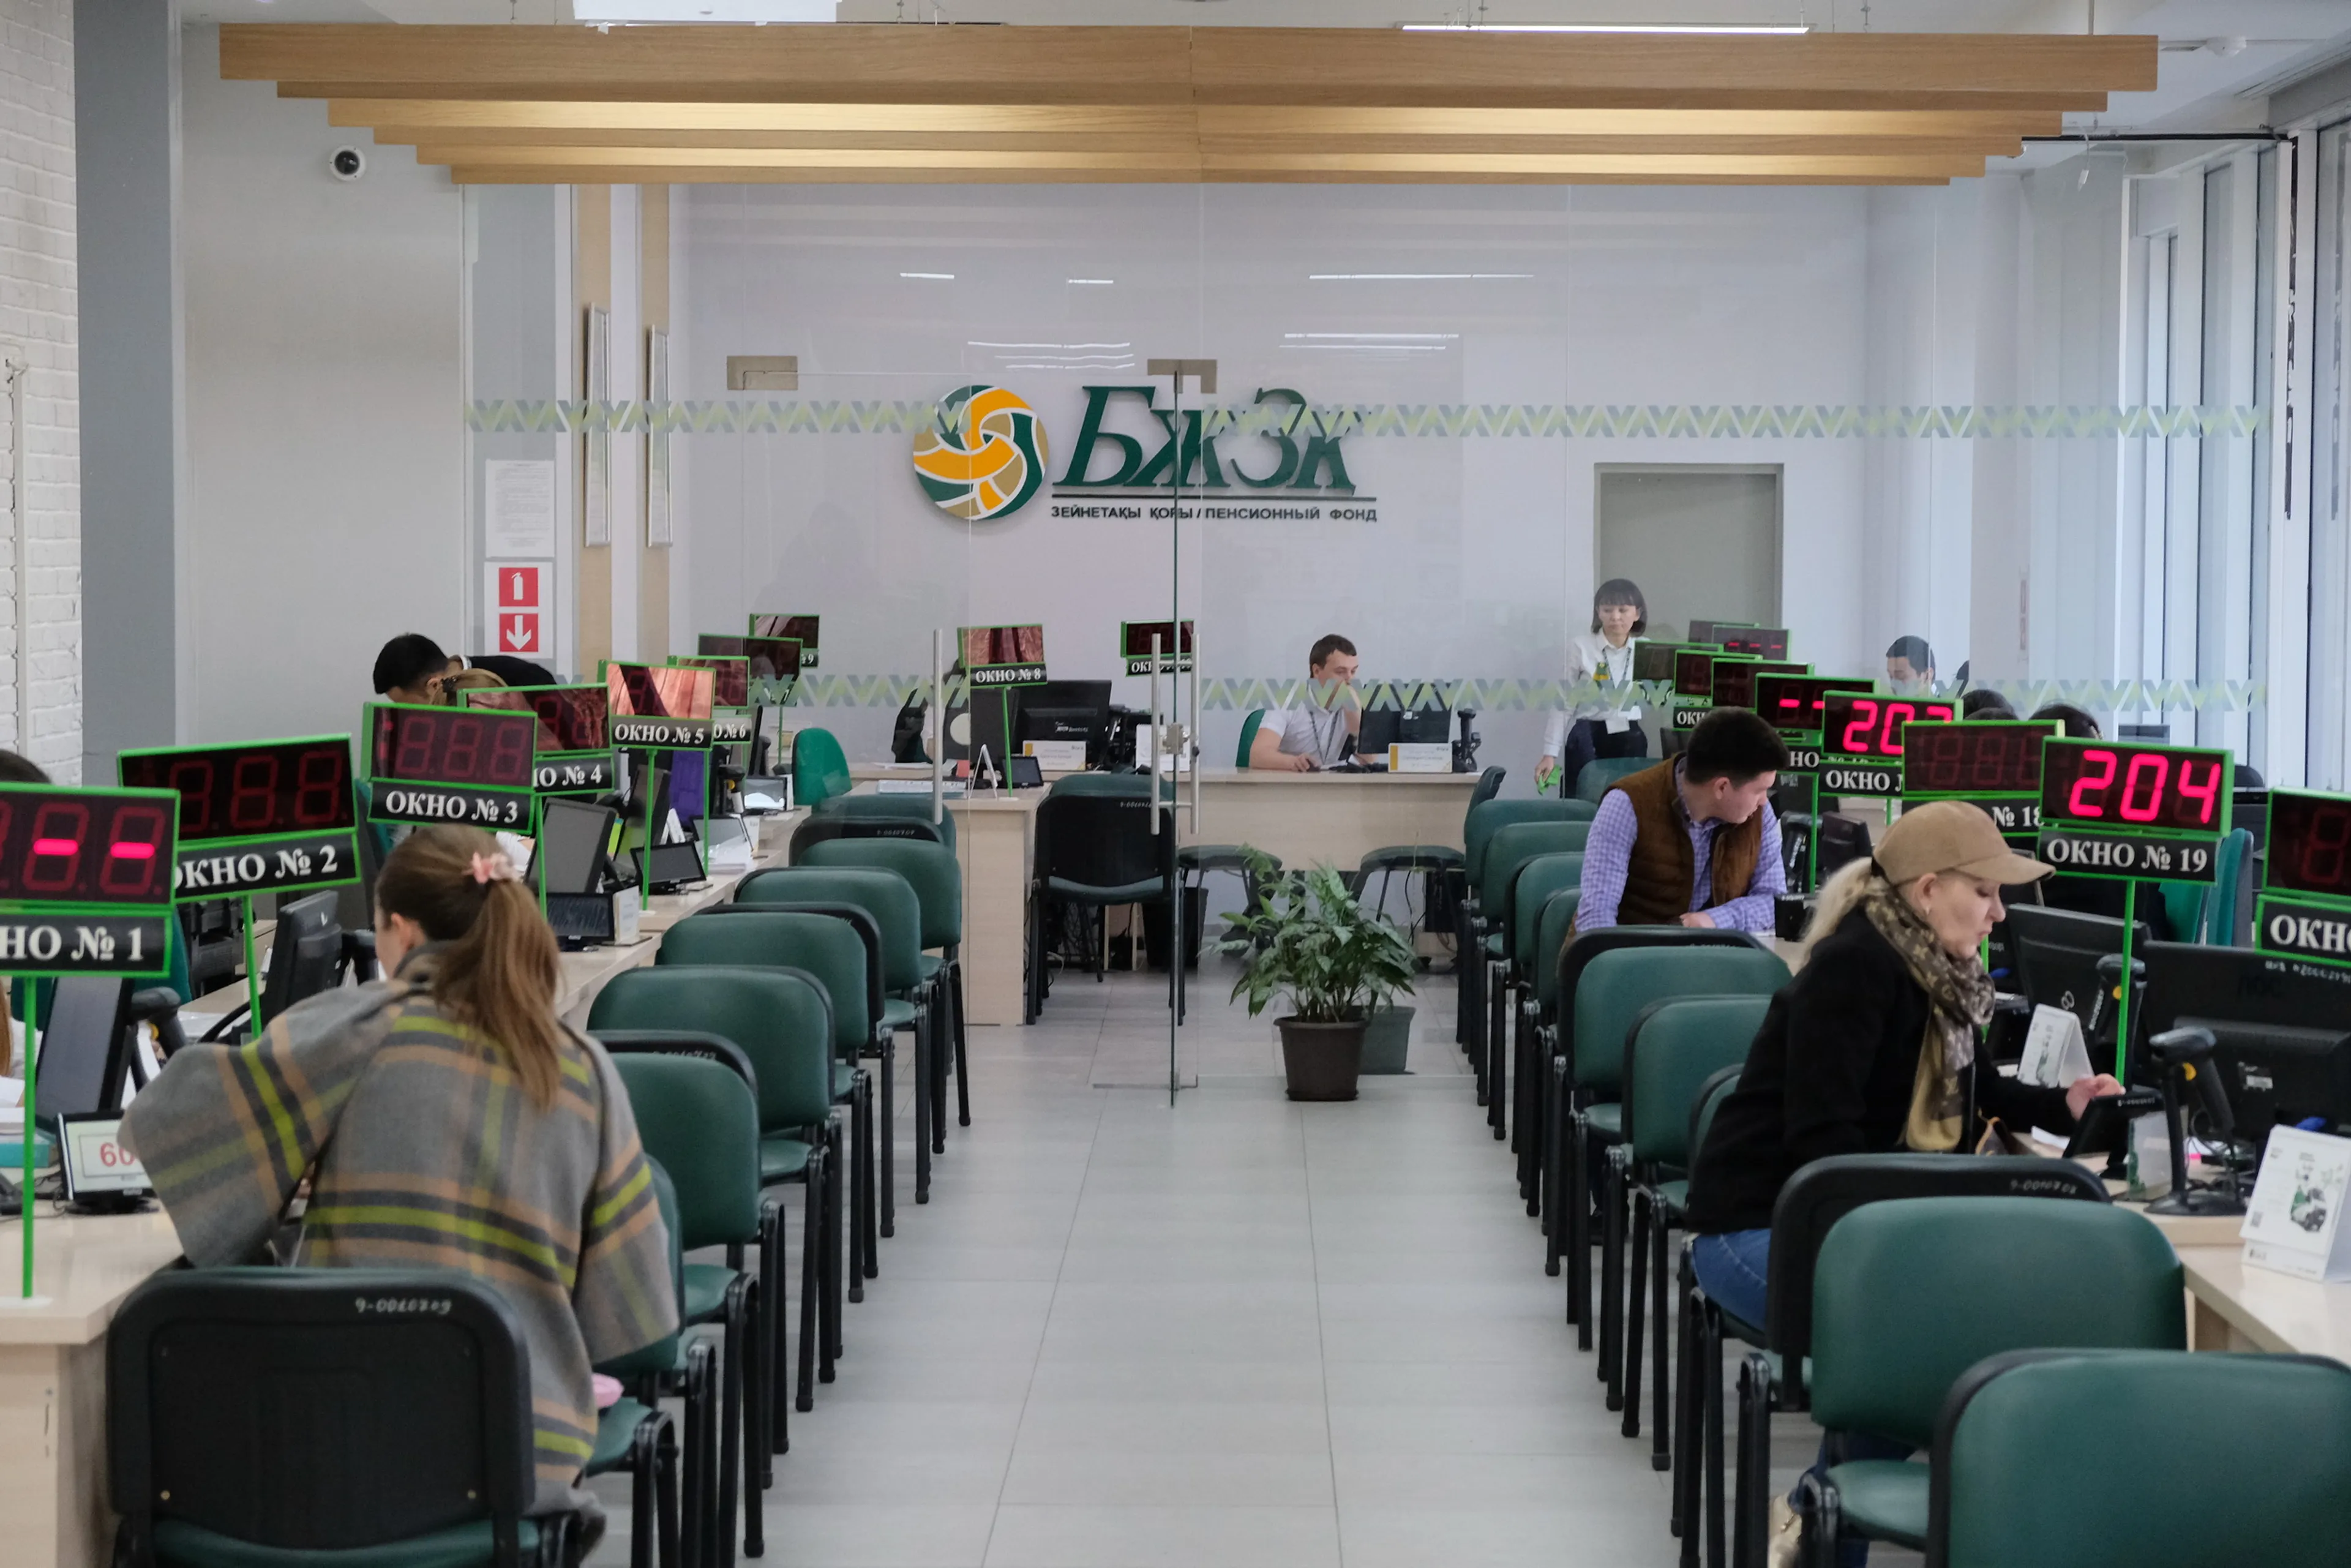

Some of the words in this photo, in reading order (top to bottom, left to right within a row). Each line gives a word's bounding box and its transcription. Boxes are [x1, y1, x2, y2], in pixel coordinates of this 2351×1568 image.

[1051, 505, 1141, 519] ЗЕЙНЕТАҚЫ
[1205, 507, 1320, 520] ПЕНСИОННЫЙ
[1329, 509, 1378, 522] ФОНД
[976, 670, 1015, 683] ОКНО
[1018, 669, 1033, 681] №
[1034, 668, 1041, 680] 8
[614, 723, 669, 743] ОКНО
[672, 726, 691, 743] №
[694, 727, 704, 745] 5
[724, 723, 737, 738] №
[739, 723, 746, 738] 6
[561, 765, 585, 786] №
[590, 763, 602, 784] 4
[1825, 770, 1891, 792] ОКНО
[2068, 750, 2221, 823] 204
[386, 790, 466, 818] ОКНО
[470, 803, 498, 822] №
[505, 800, 518, 823] 3
[1992, 806, 2015, 827] №
[275, 847, 312, 879] №
[321, 844, 337, 873] 2
[2046, 839, 2135, 868] ОКНО
[2141, 845, 2170, 871] №
[2180, 848, 2207, 872] 19
[70, 925, 116, 961] №
[127, 926, 144, 961] 1
[2270, 914, 2351, 953] ОКН
